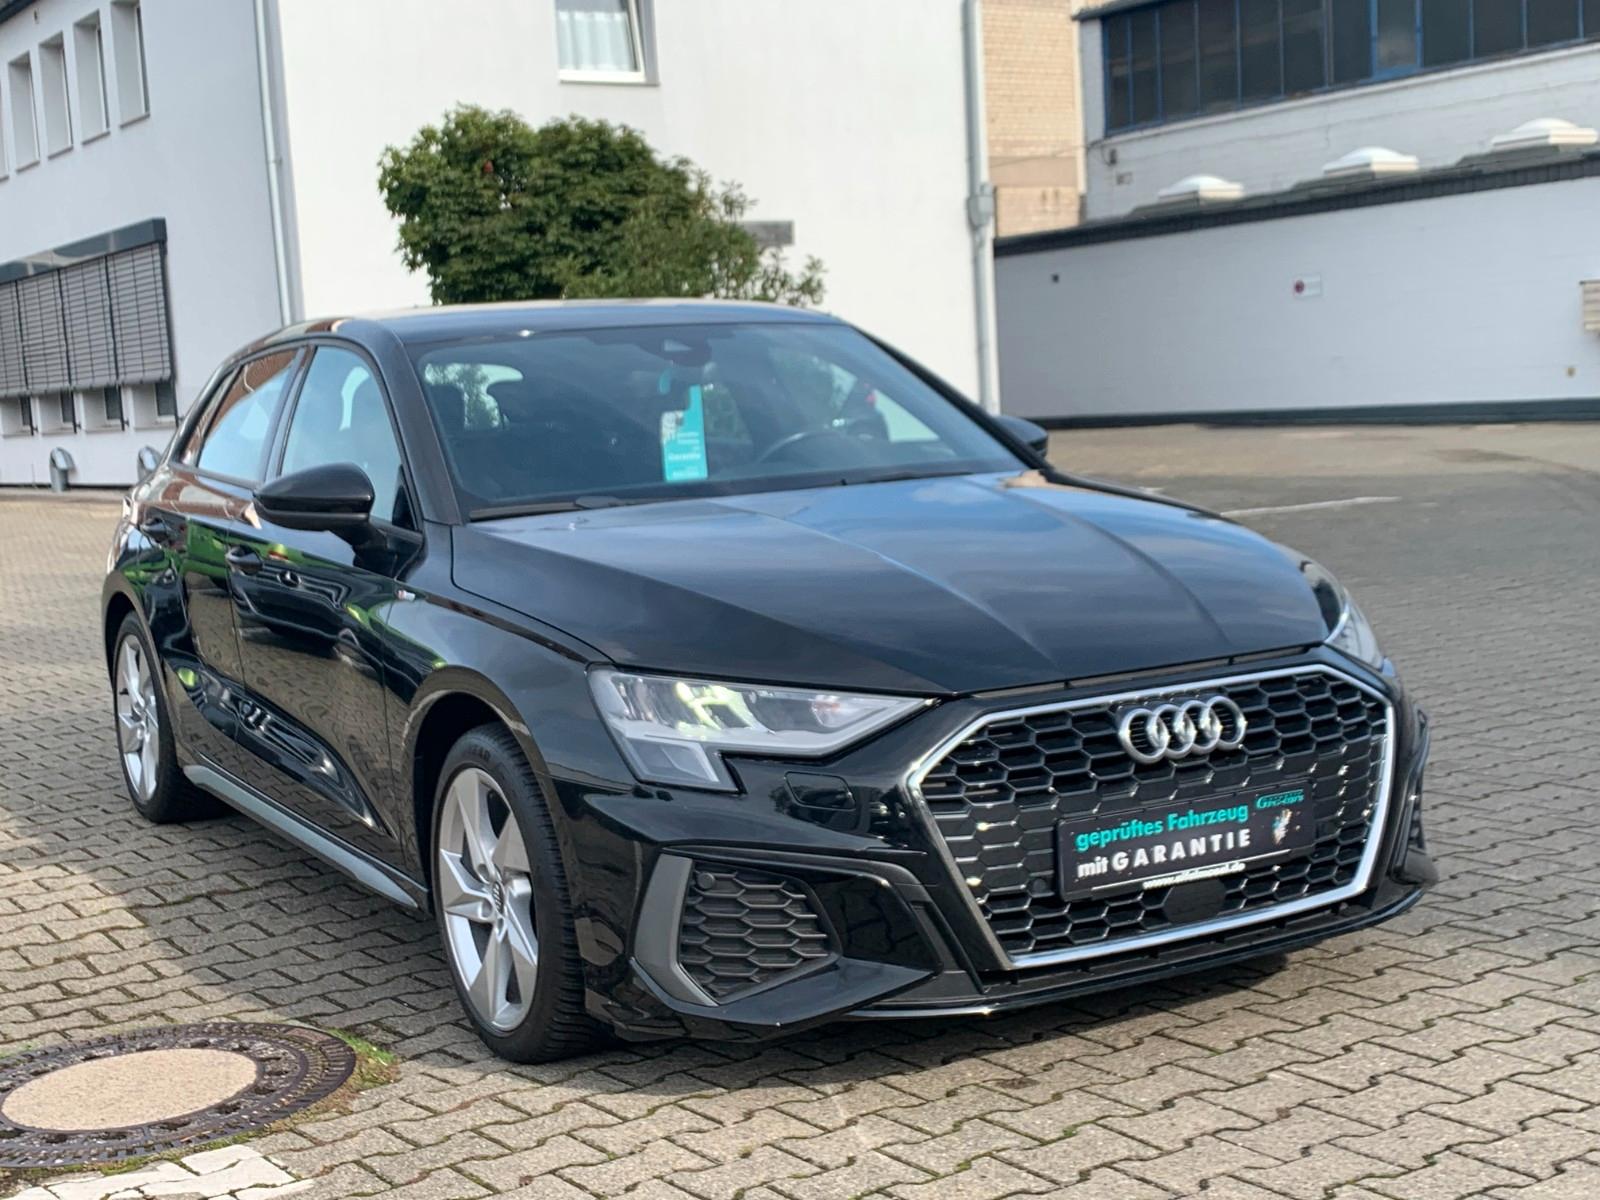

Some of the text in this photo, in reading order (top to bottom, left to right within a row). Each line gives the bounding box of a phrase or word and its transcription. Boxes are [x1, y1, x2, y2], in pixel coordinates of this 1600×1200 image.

[1075, 804, 1249, 852] geprüftes Fahrzeug
[1077, 857, 1109, 878] mit
[1111, 828, 1252, 871] GARANTIE
